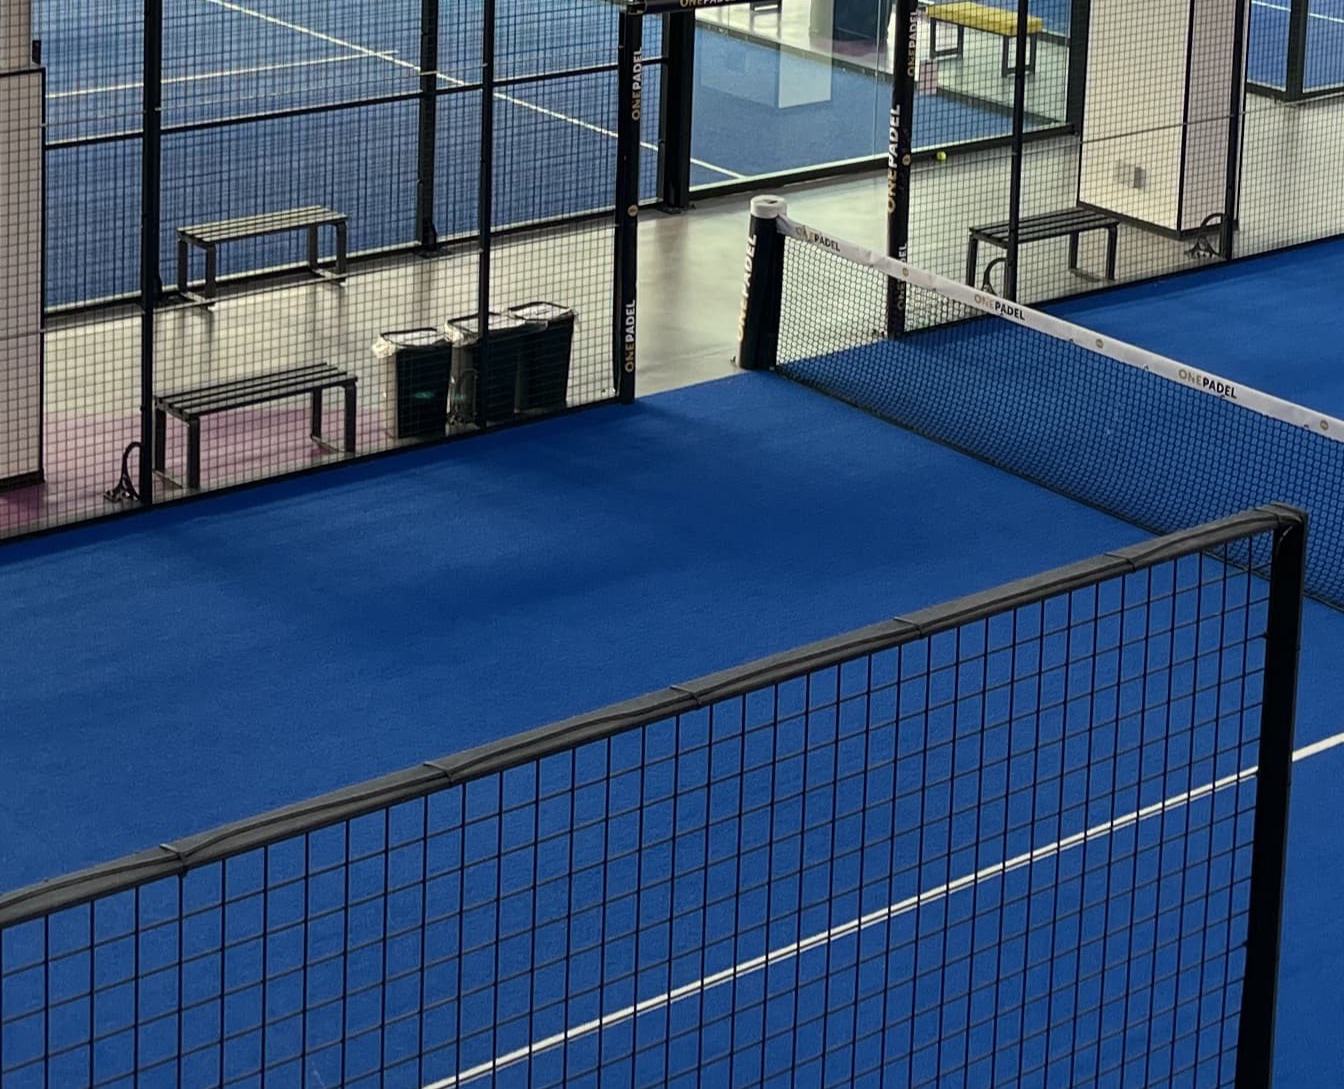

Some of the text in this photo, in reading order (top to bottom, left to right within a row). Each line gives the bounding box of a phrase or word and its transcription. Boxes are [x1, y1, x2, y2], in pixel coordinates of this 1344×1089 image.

[907, 9, 919, 77] ONEPADEL
[631, 46, 642, 121] ONEPADEL
[887, 103, 901, 215] ONEPADEL
[795, 226, 841, 252] ONEPADEL
[896, 243, 908, 311] ONEEL
[974, 294, 1026, 322] ONEPADEL
[624, 299, 636, 373] ONEPADEL
[1178, 368, 1238, 399] ONEPADEL
